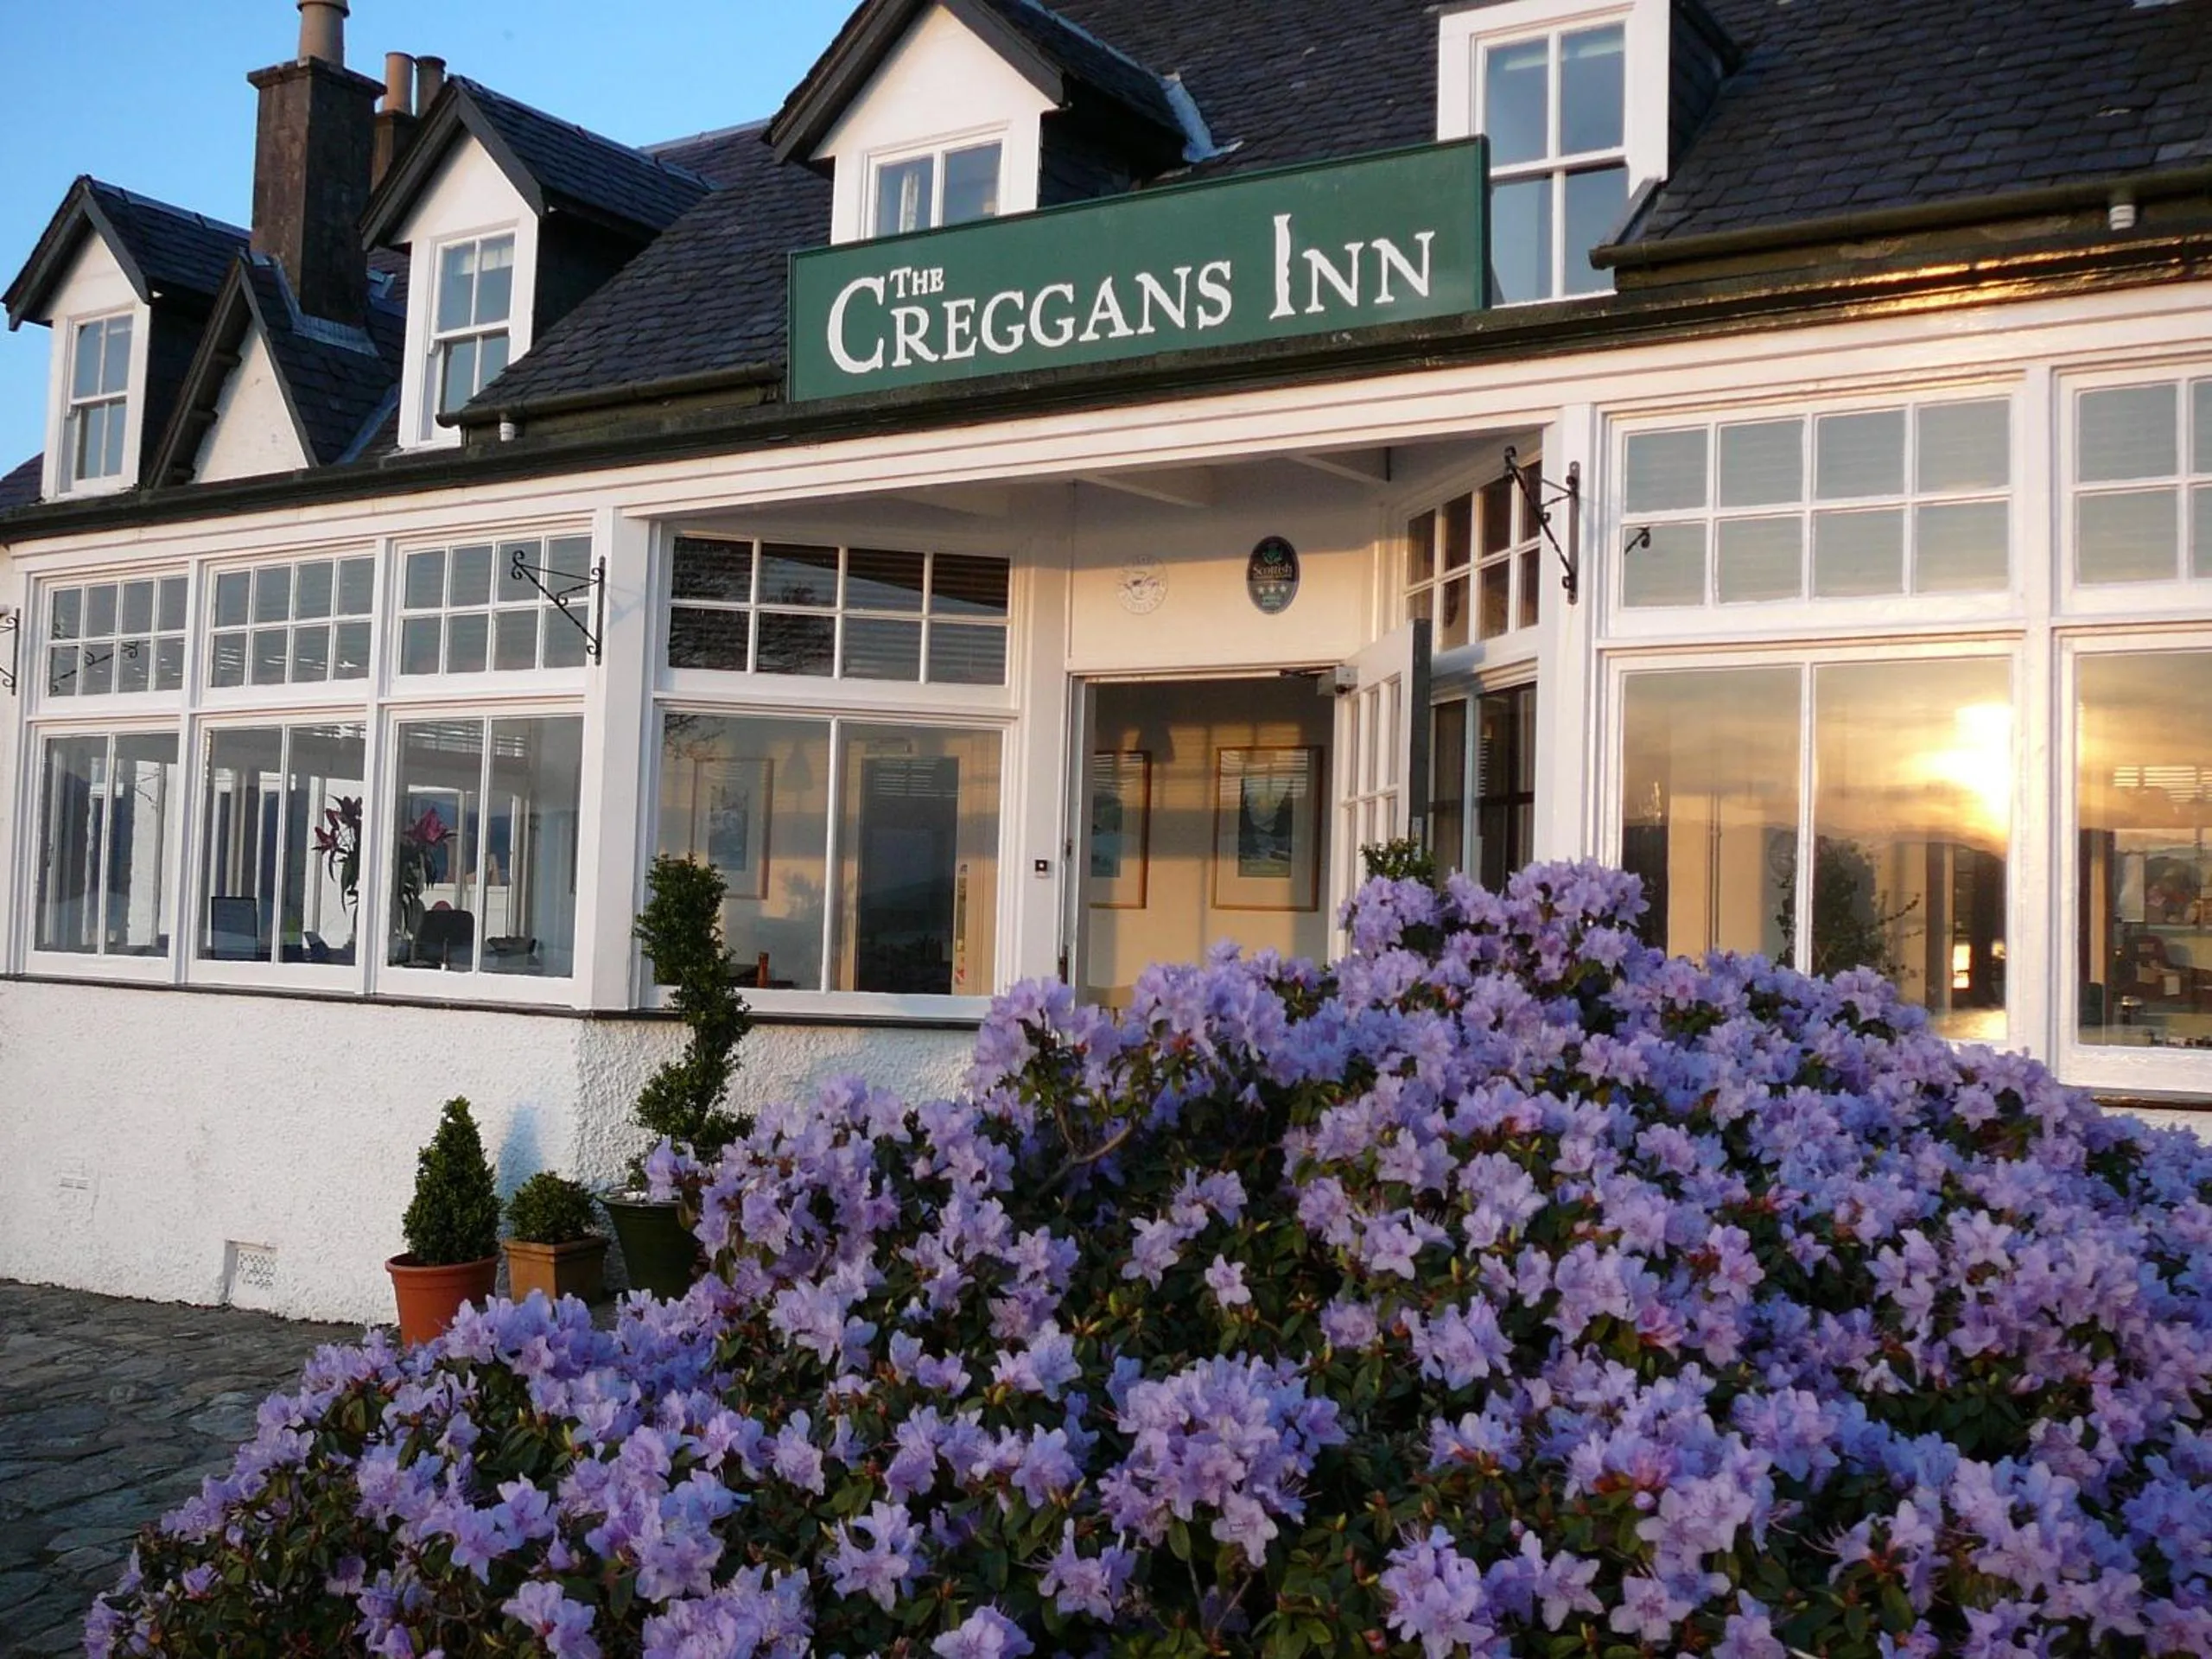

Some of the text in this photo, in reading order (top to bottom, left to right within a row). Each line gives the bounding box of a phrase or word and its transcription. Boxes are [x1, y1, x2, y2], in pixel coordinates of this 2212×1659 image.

[827, 213, 1435, 374] CREGGANS INN
[888, 266, 944, 299] THE
